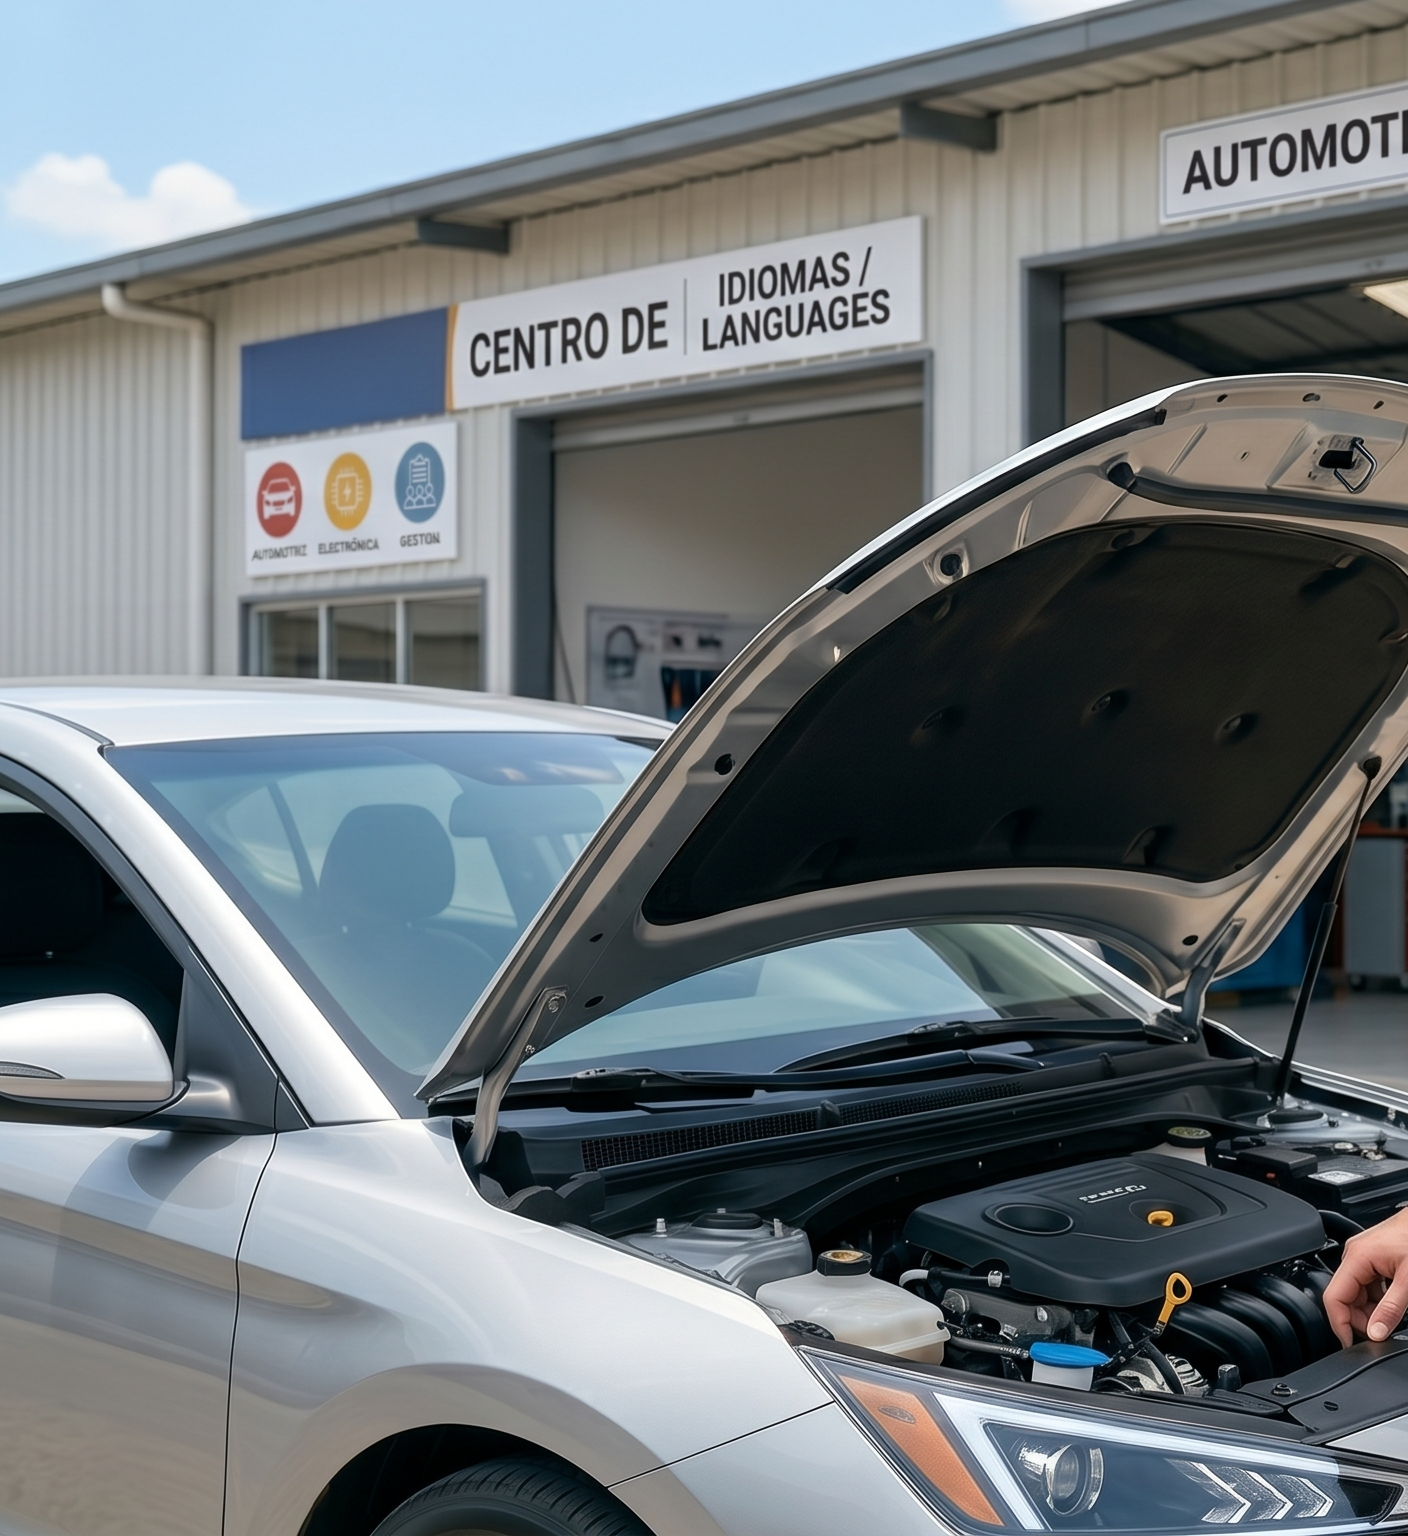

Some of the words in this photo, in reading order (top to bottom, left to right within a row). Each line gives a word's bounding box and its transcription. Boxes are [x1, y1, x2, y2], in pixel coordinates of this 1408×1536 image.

[718, 250, 852, 308] IDIOMAS
[470, 312, 610, 379] CENTRO
[621, 301, 670, 355] DE
[702, 289, 892, 352] LANGUAGES
